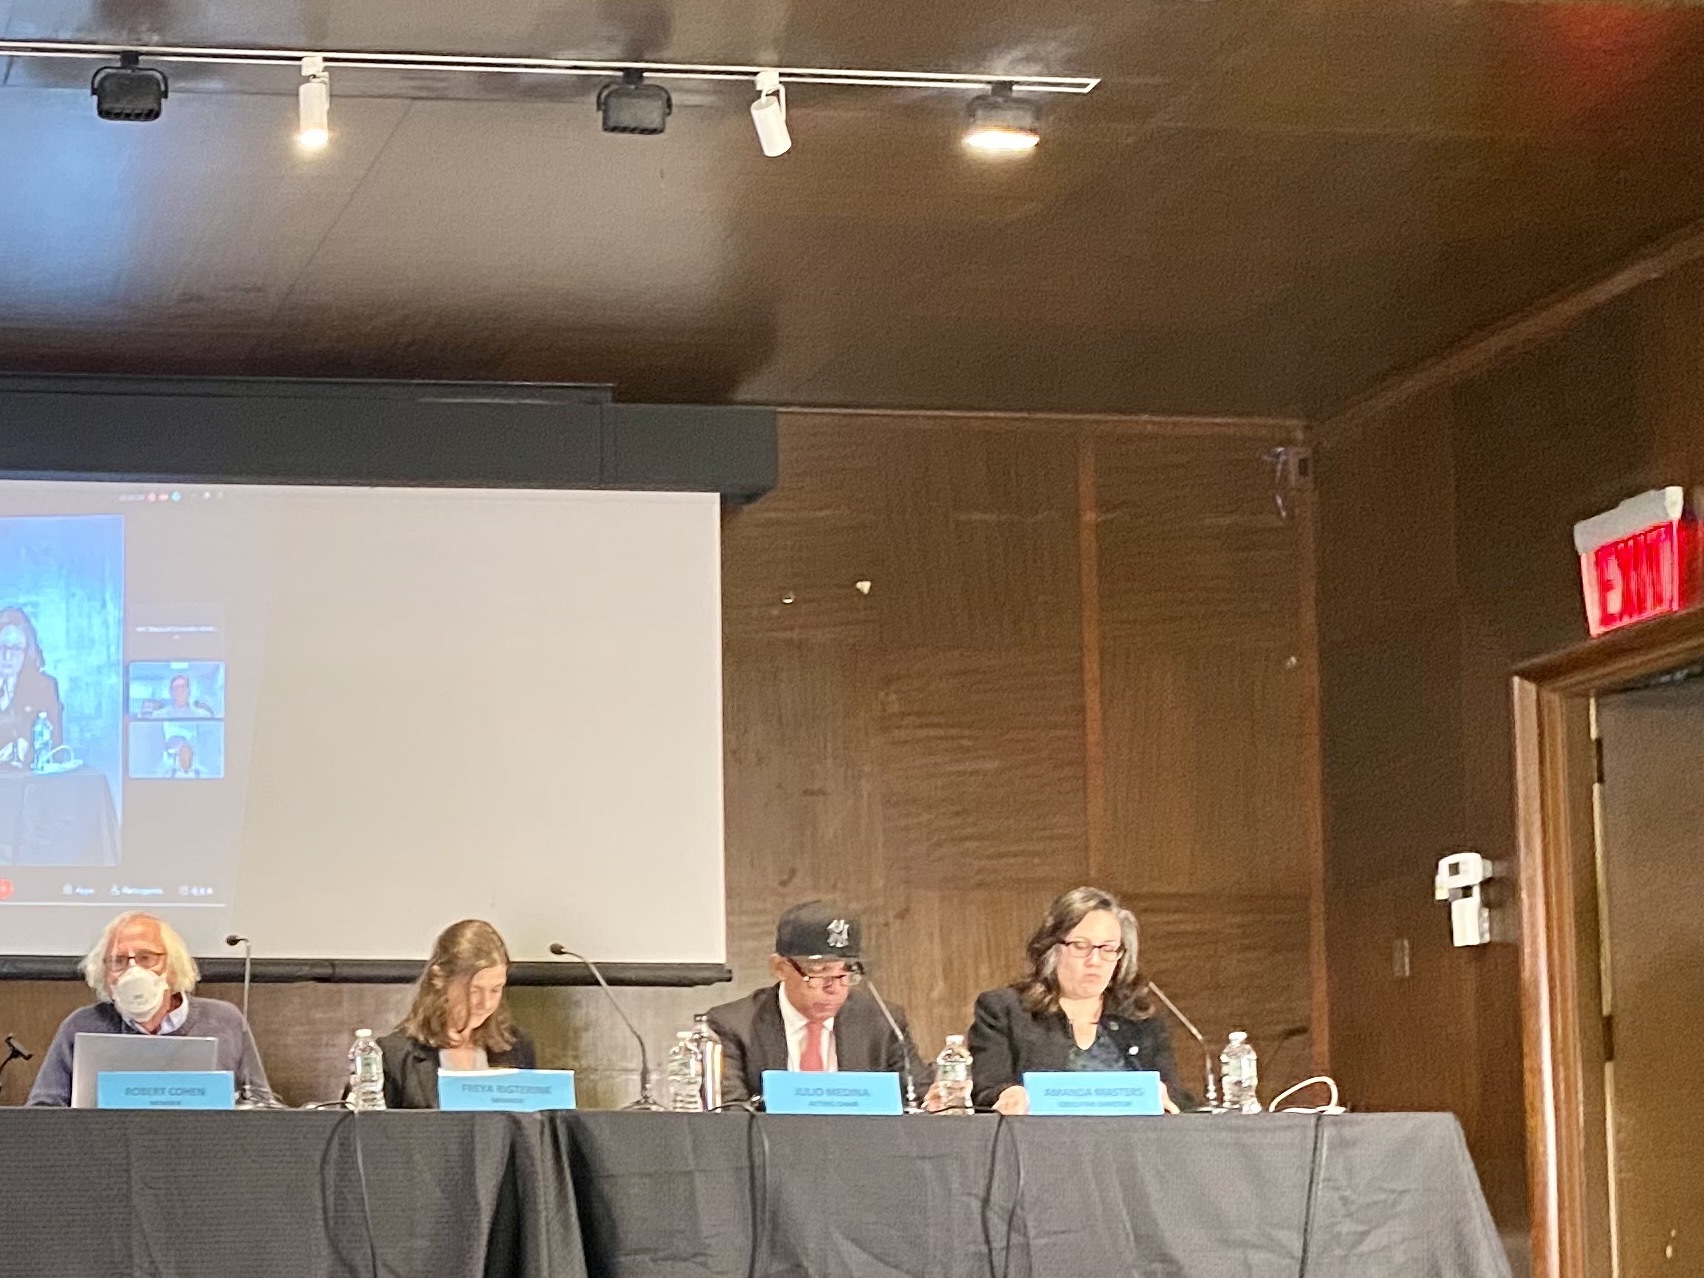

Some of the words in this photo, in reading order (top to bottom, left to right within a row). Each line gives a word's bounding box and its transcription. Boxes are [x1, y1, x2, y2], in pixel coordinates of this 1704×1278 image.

[1594, 521, 1673, 628] EXIT
[124, 1087, 166, 1096] ROBERT
[168, 1087, 206, 1097] COHEN
